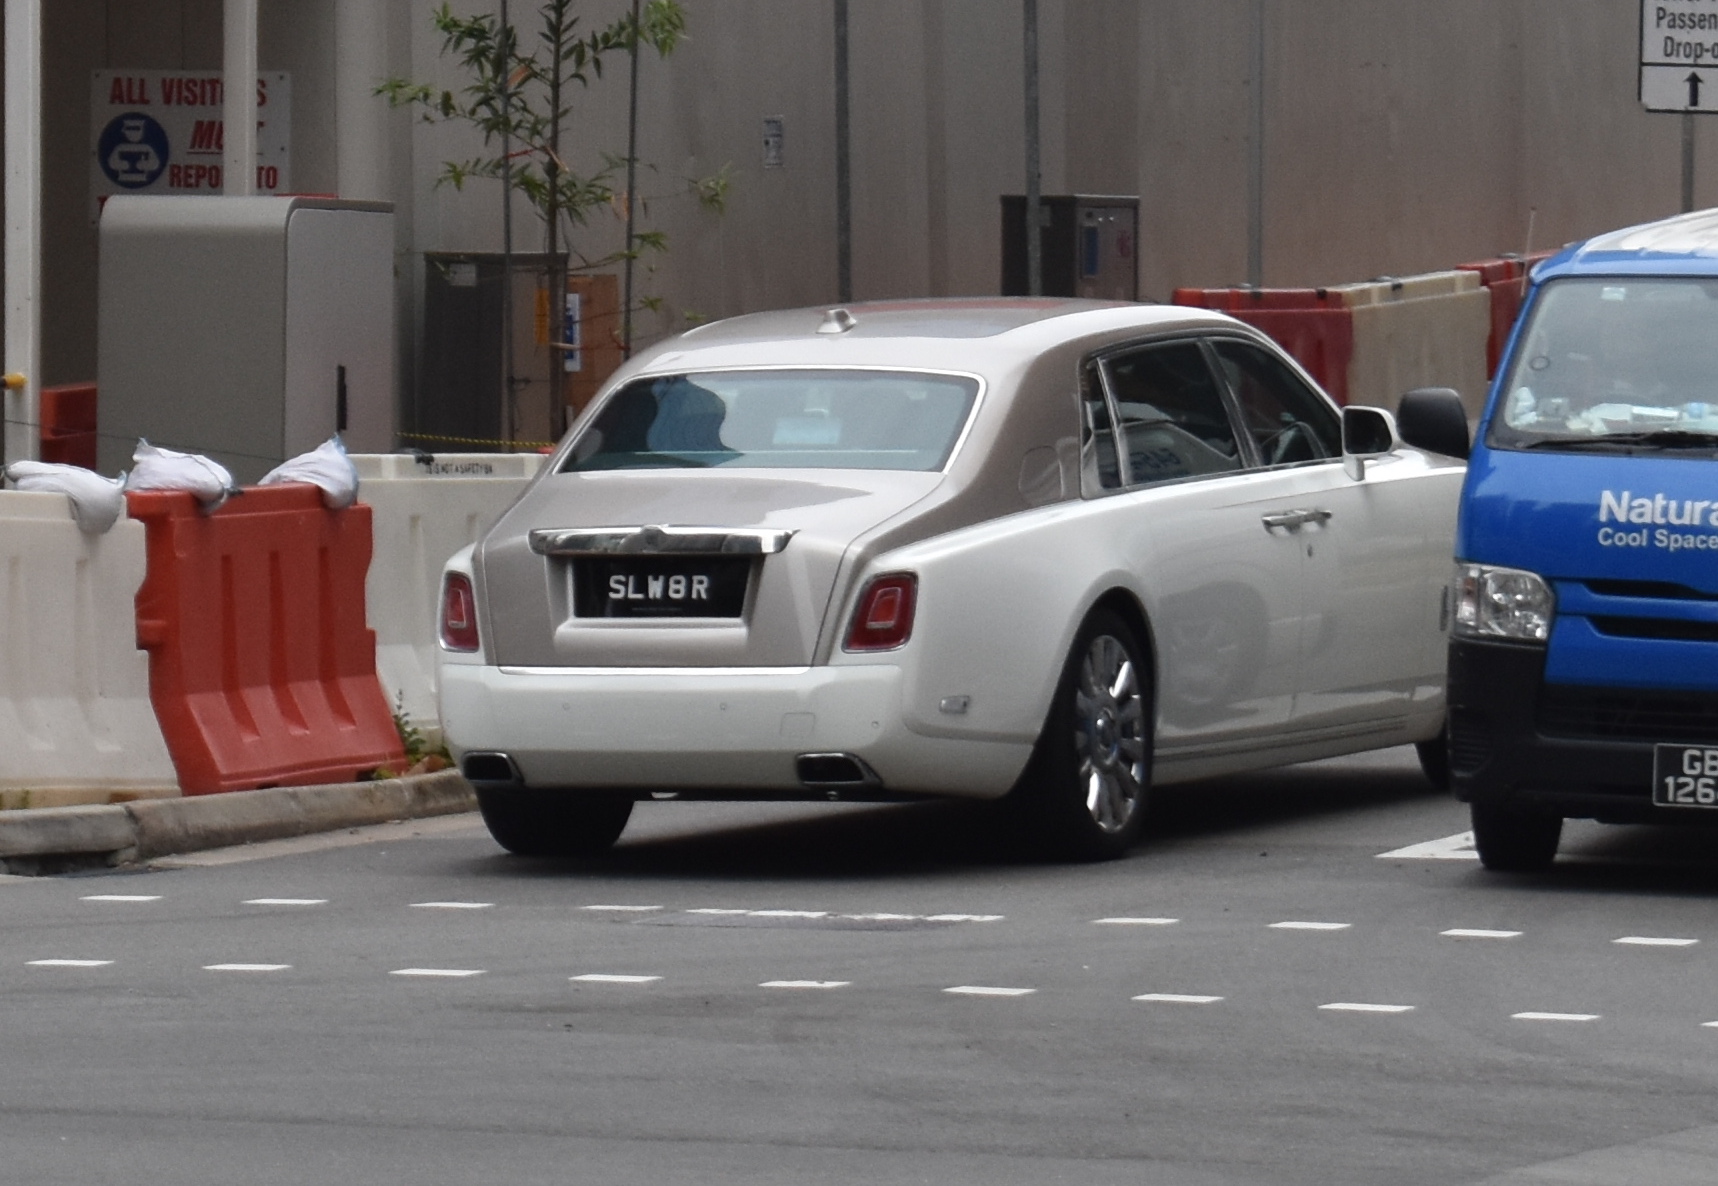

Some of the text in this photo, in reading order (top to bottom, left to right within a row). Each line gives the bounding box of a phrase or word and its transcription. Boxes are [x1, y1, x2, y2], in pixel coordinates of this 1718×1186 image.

[1656, 6, 1718, 30] Passen
[1663, 35, 1718, 63] Drop-o
[109, 77, 267, 107] ALL VISITS
[169, 164, 223, 188] REPO
[1597, 527, 1718, 552] Cool Space
[1682, 748, 1718, 776] GB
[1664, 775, 1718, 803] 126
